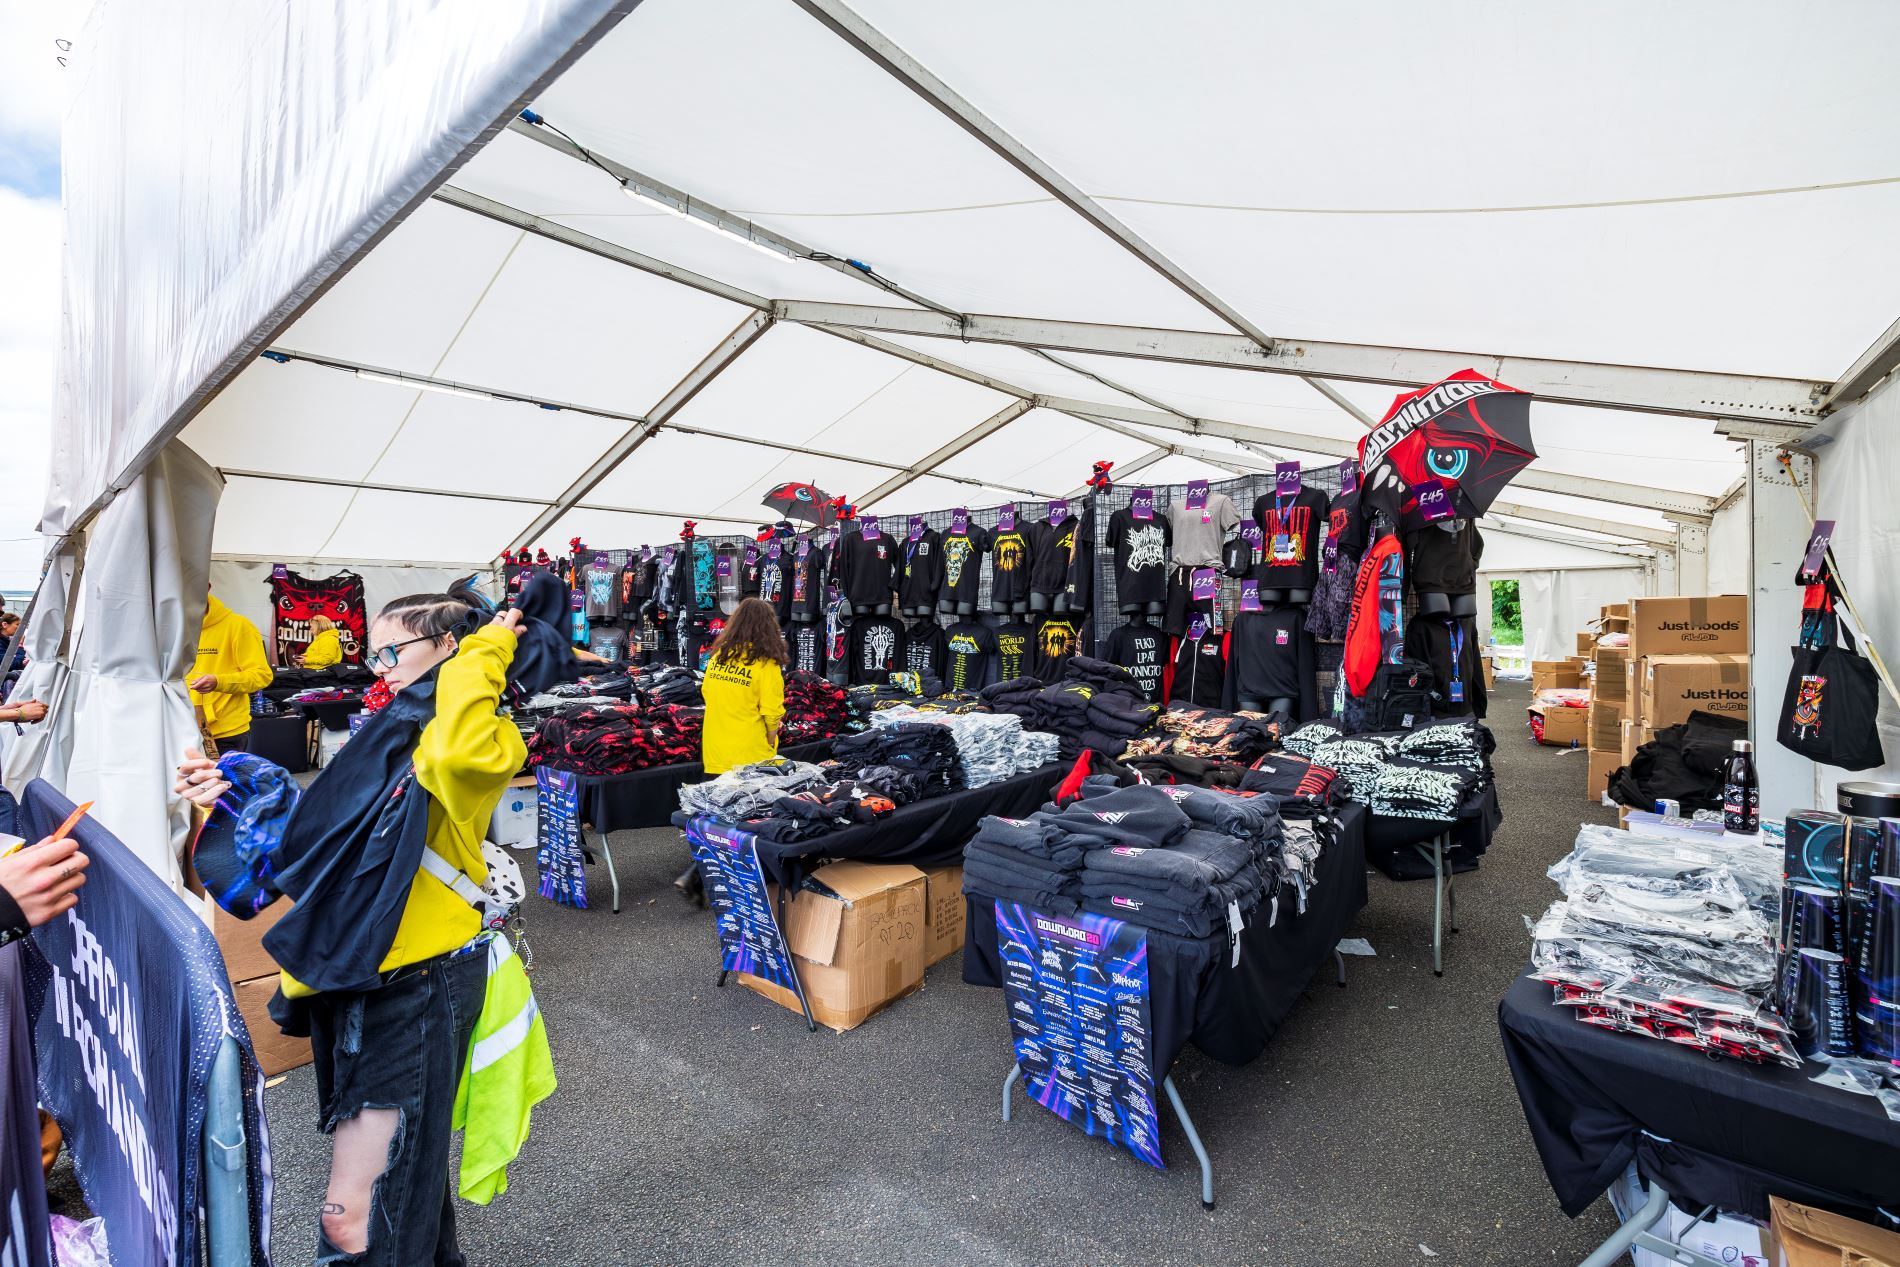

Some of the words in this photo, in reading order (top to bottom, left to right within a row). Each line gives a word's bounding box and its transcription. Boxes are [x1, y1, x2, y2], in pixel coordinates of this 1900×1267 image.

[1276, 470, 1300, 483] £25
[1188, 487, 1208, 499] £30
[1418, 488, 1444, 507] £45
[1132, 497, 1153, 509] £35
[1241, 526, 1262, 540] £28
[1193, 577, 1215, 589] £25
[1657, 621, 1690, 631] Just
[999, 636, 1025, 645] WORLD
[1137, 652, 1148, 664] UP
[1681, 688, 1718, 700] Just
[1718, 689, 1749, 700] Hoo
